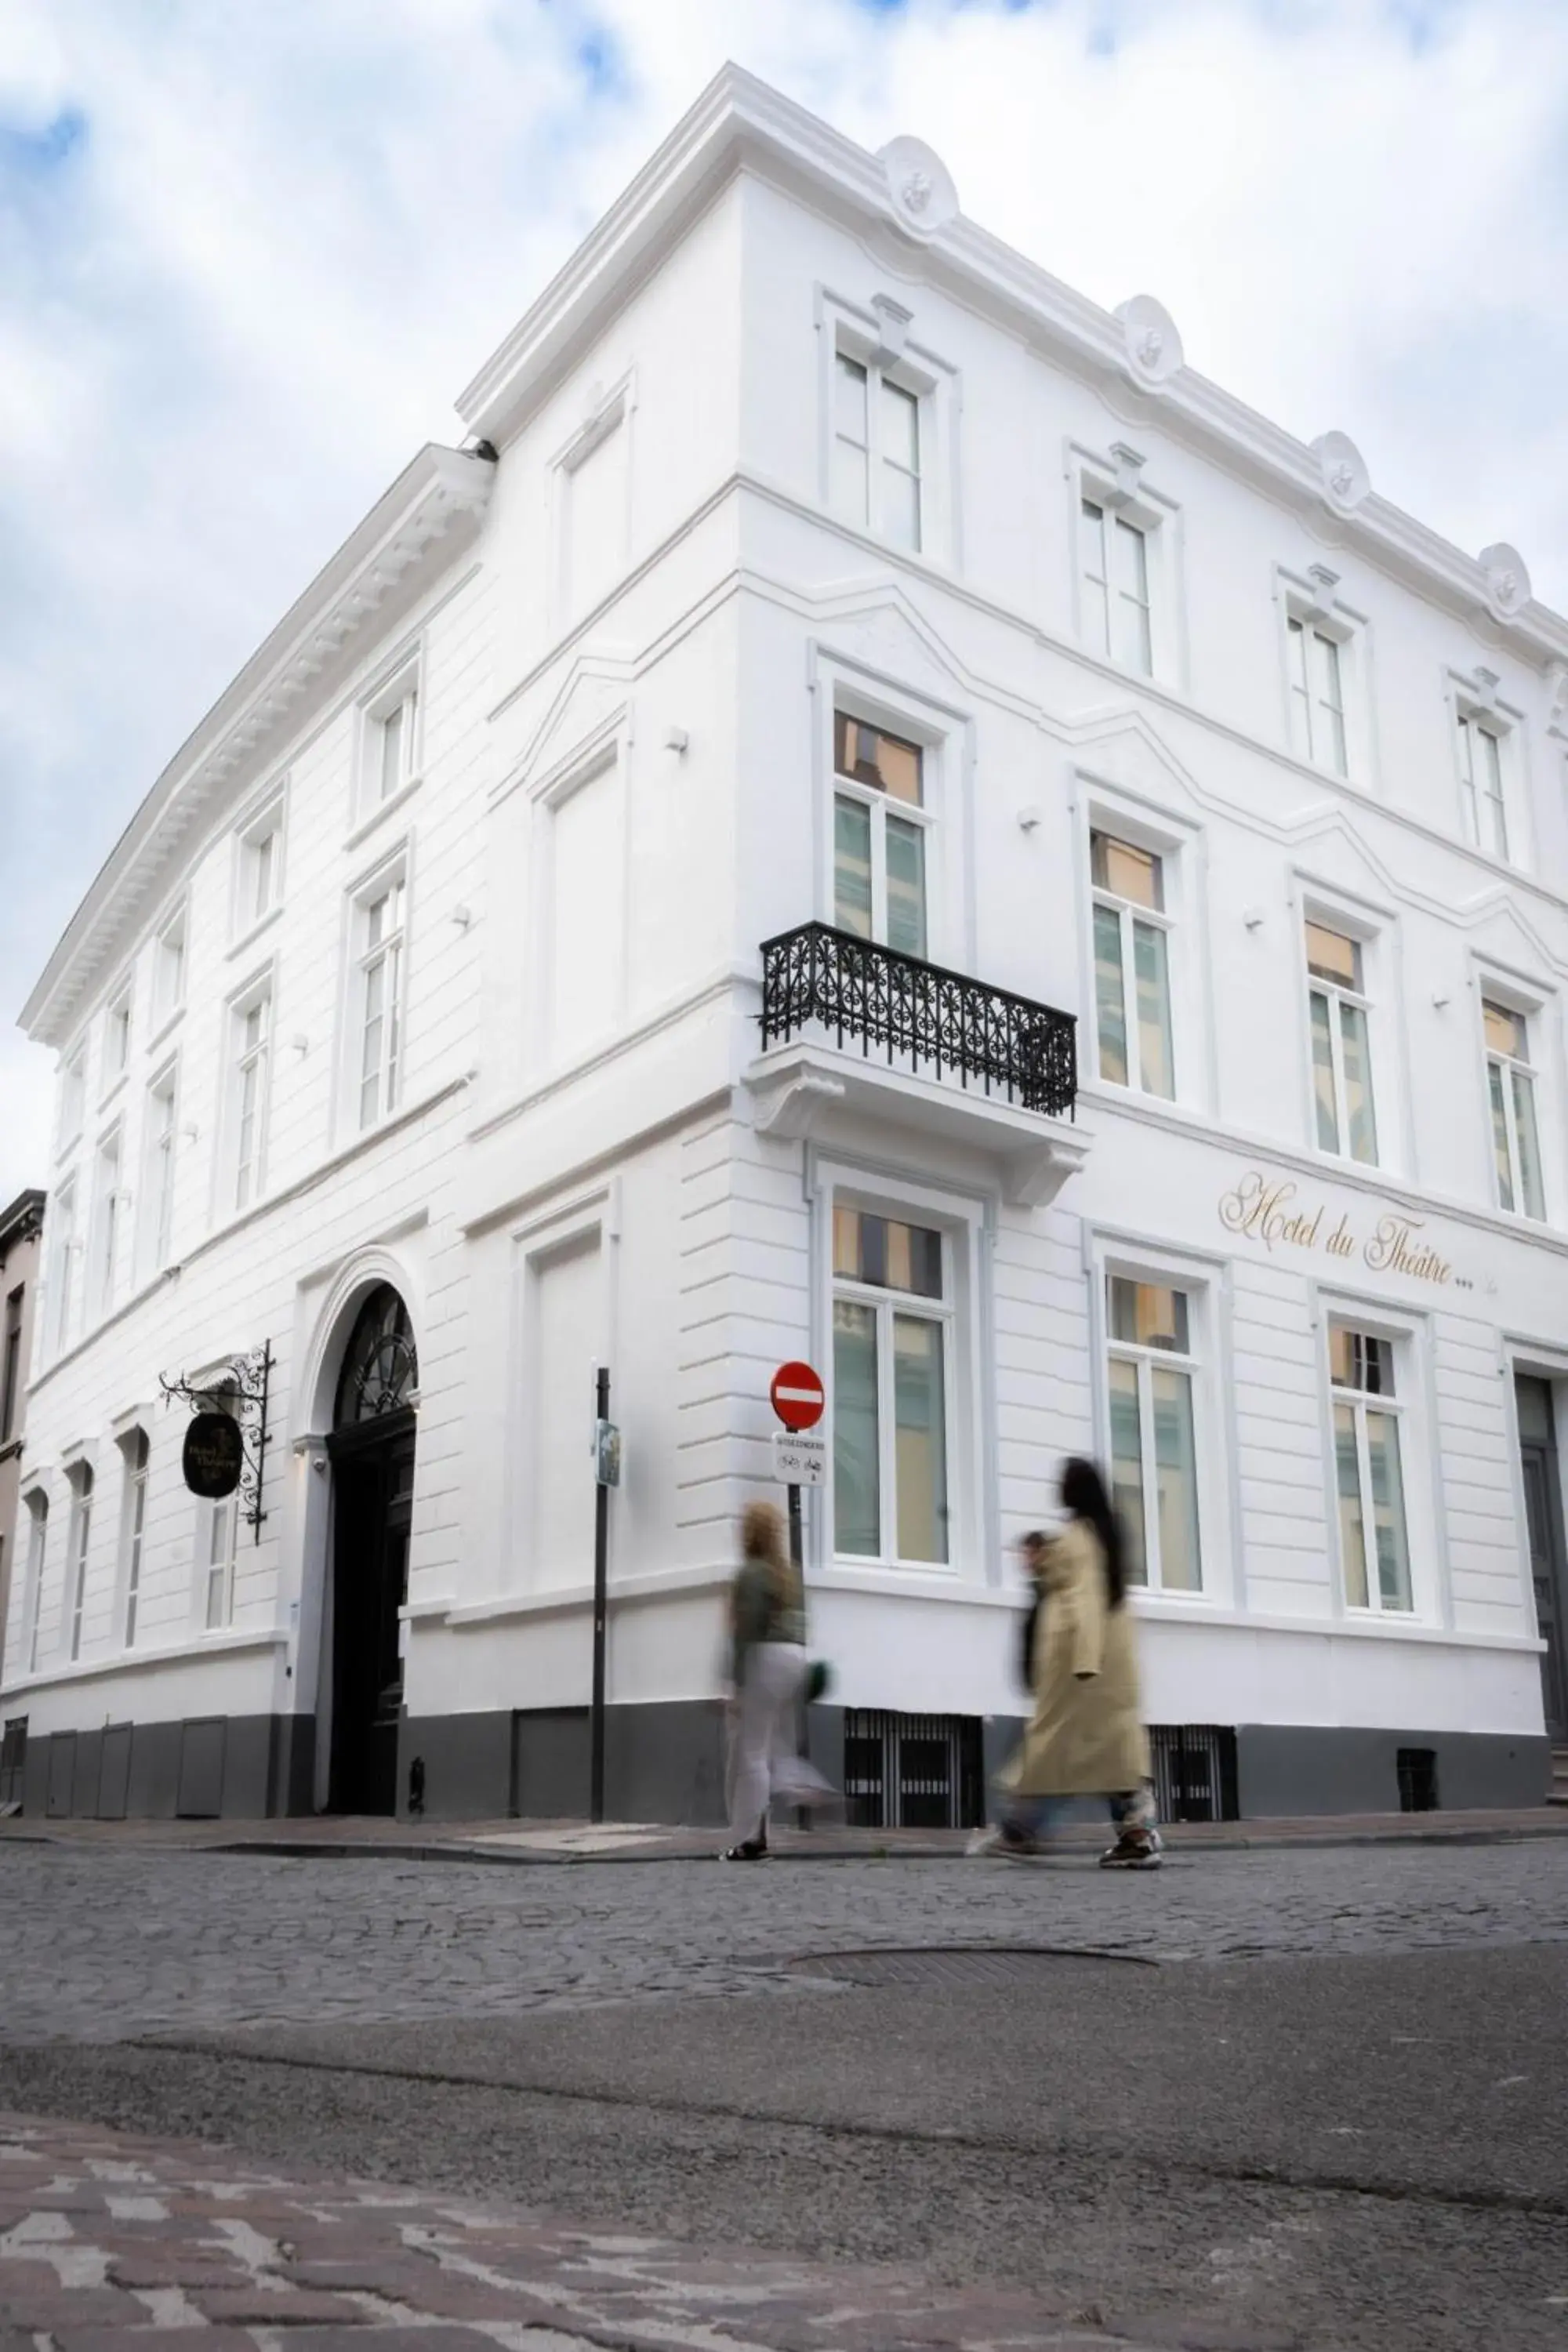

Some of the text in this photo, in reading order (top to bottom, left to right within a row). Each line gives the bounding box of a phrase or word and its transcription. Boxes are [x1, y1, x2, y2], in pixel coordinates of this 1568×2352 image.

[1219, 1171, 1451, 1284] Hotel du Théâtre
